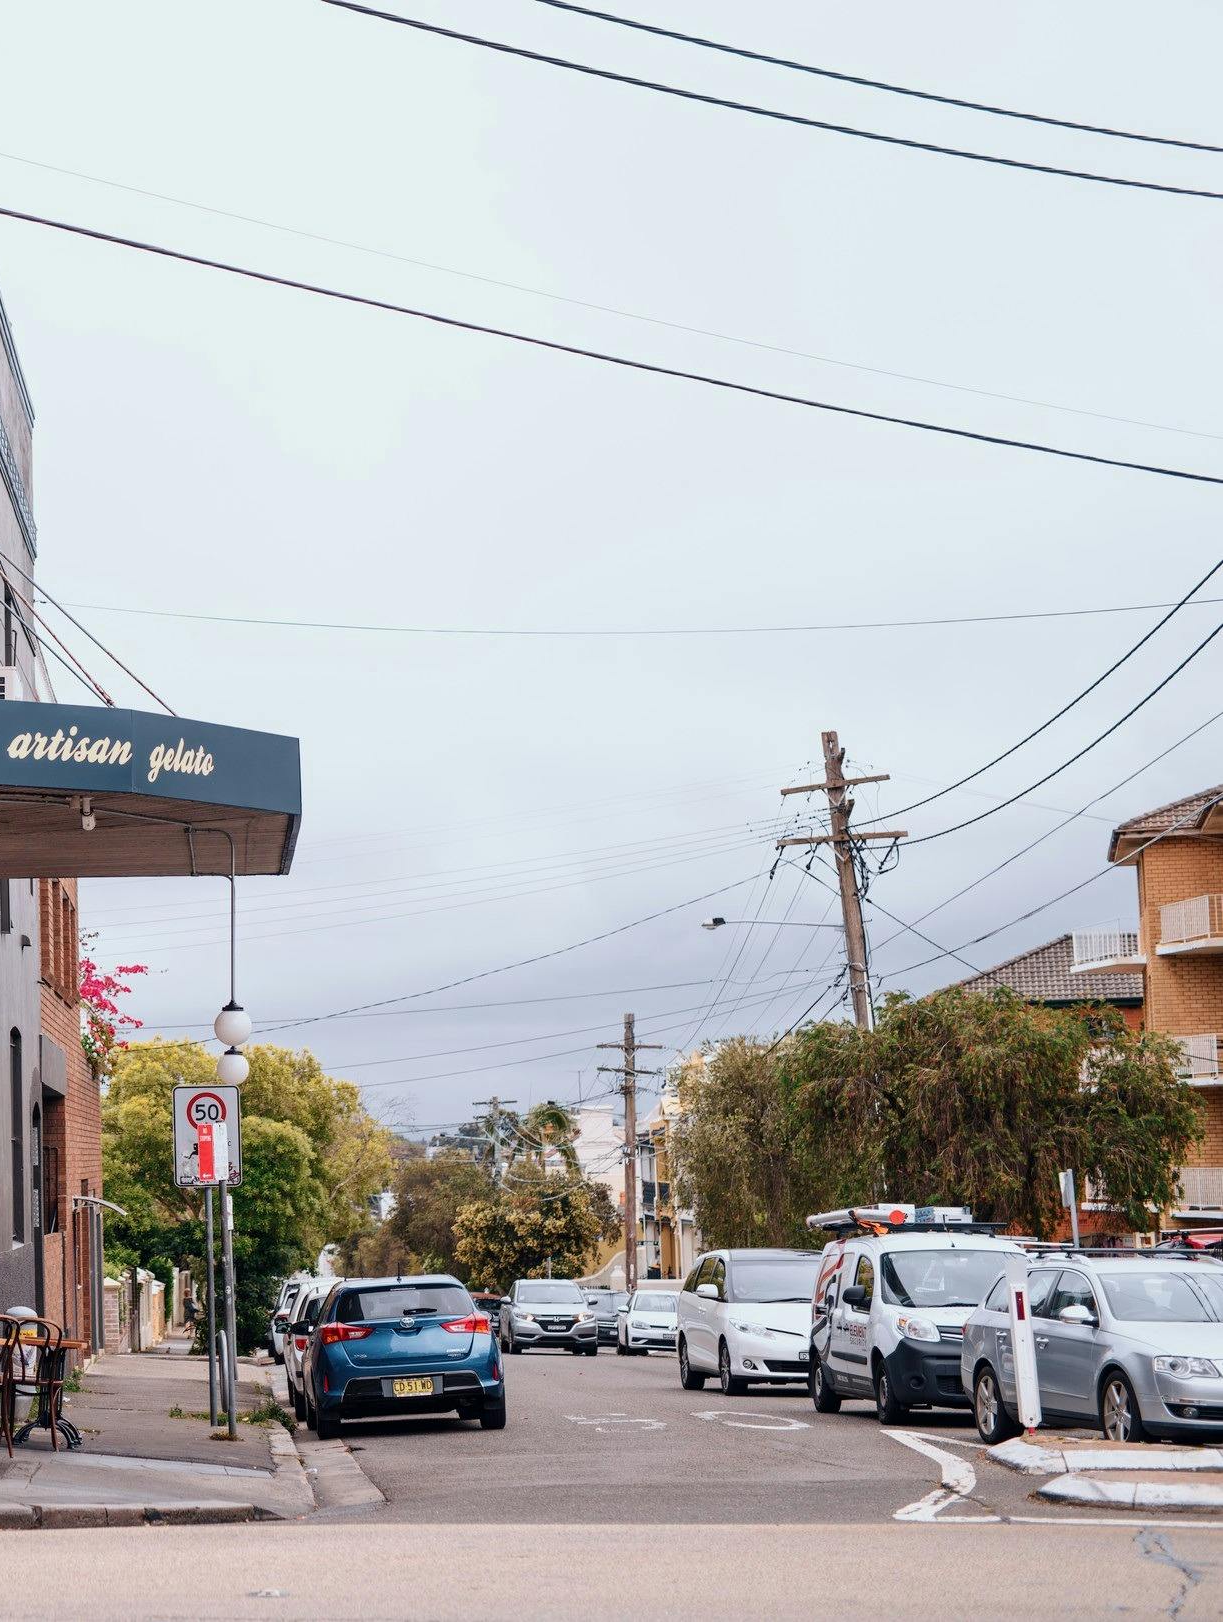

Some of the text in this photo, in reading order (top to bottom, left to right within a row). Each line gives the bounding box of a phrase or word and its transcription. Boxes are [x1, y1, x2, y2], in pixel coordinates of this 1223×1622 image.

[7, 725, 215, 783] artisan gelato
[195, 1103, 220, 1121] 50
